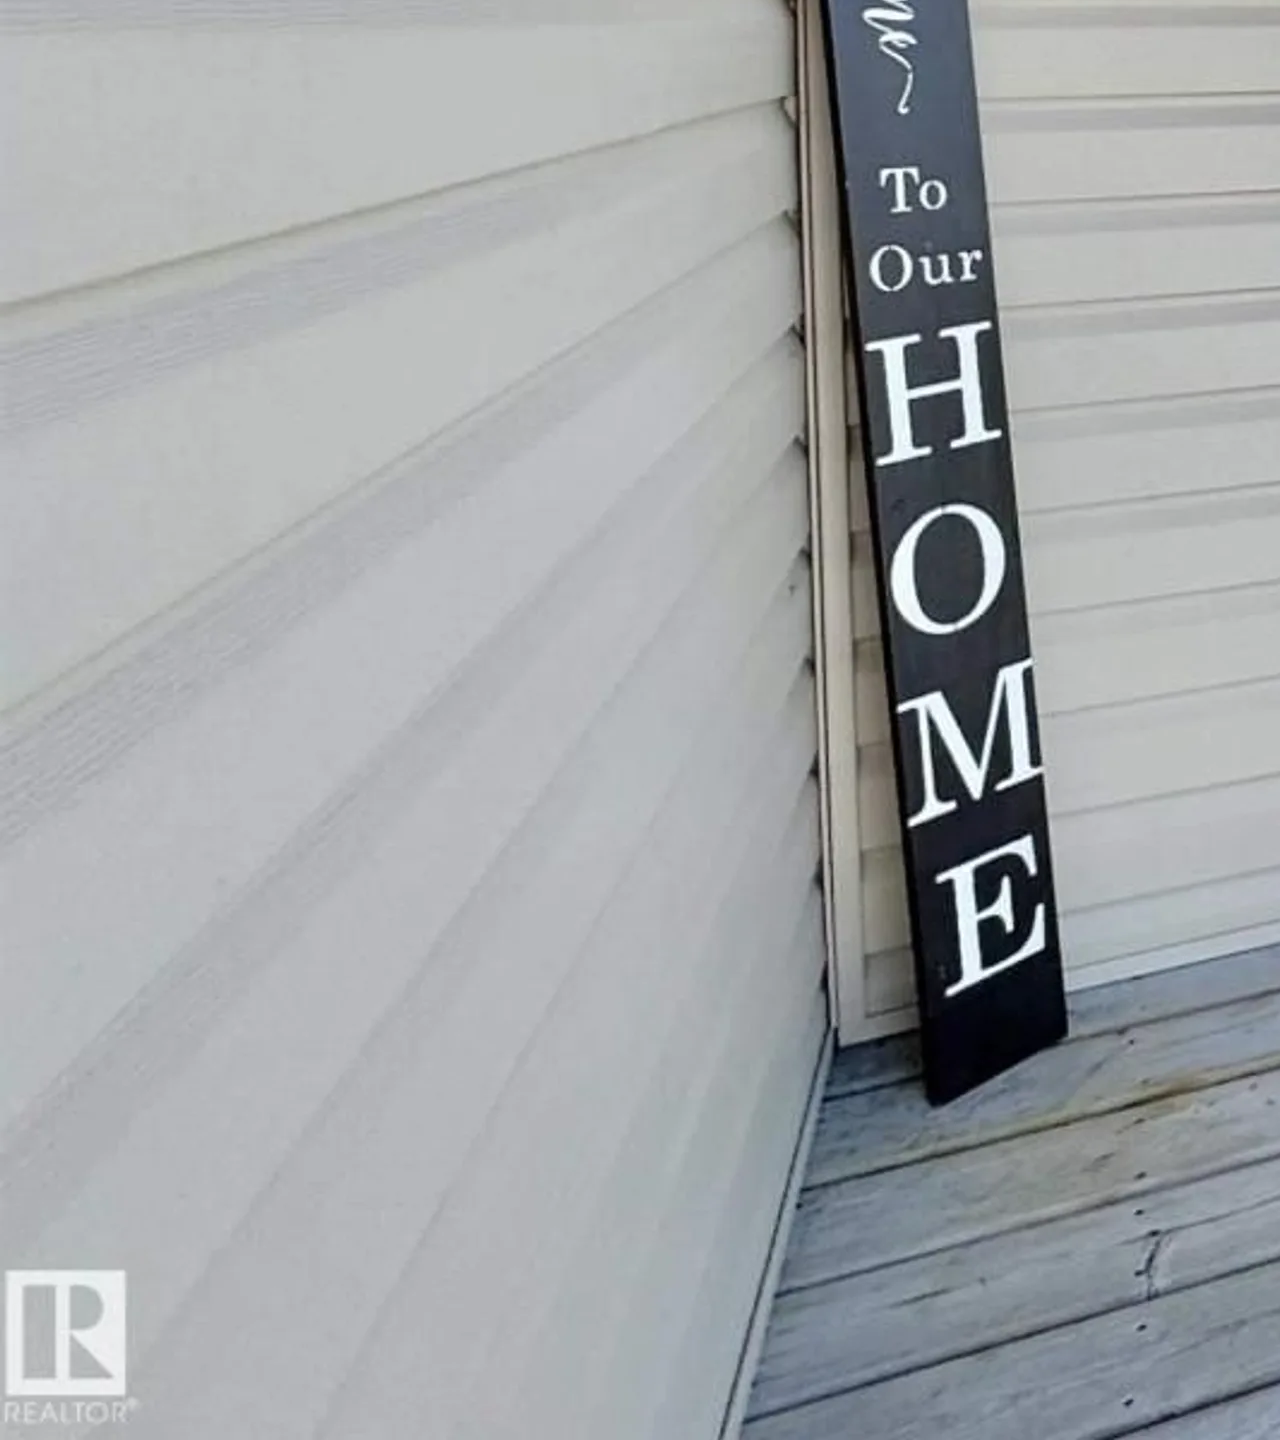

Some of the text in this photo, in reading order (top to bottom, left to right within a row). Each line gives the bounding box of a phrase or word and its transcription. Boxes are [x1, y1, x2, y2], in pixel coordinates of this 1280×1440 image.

[880, 166, 947, 213] To
[869, 244, 982, 291] Our
[864, 320, 1046, 998] HOME
